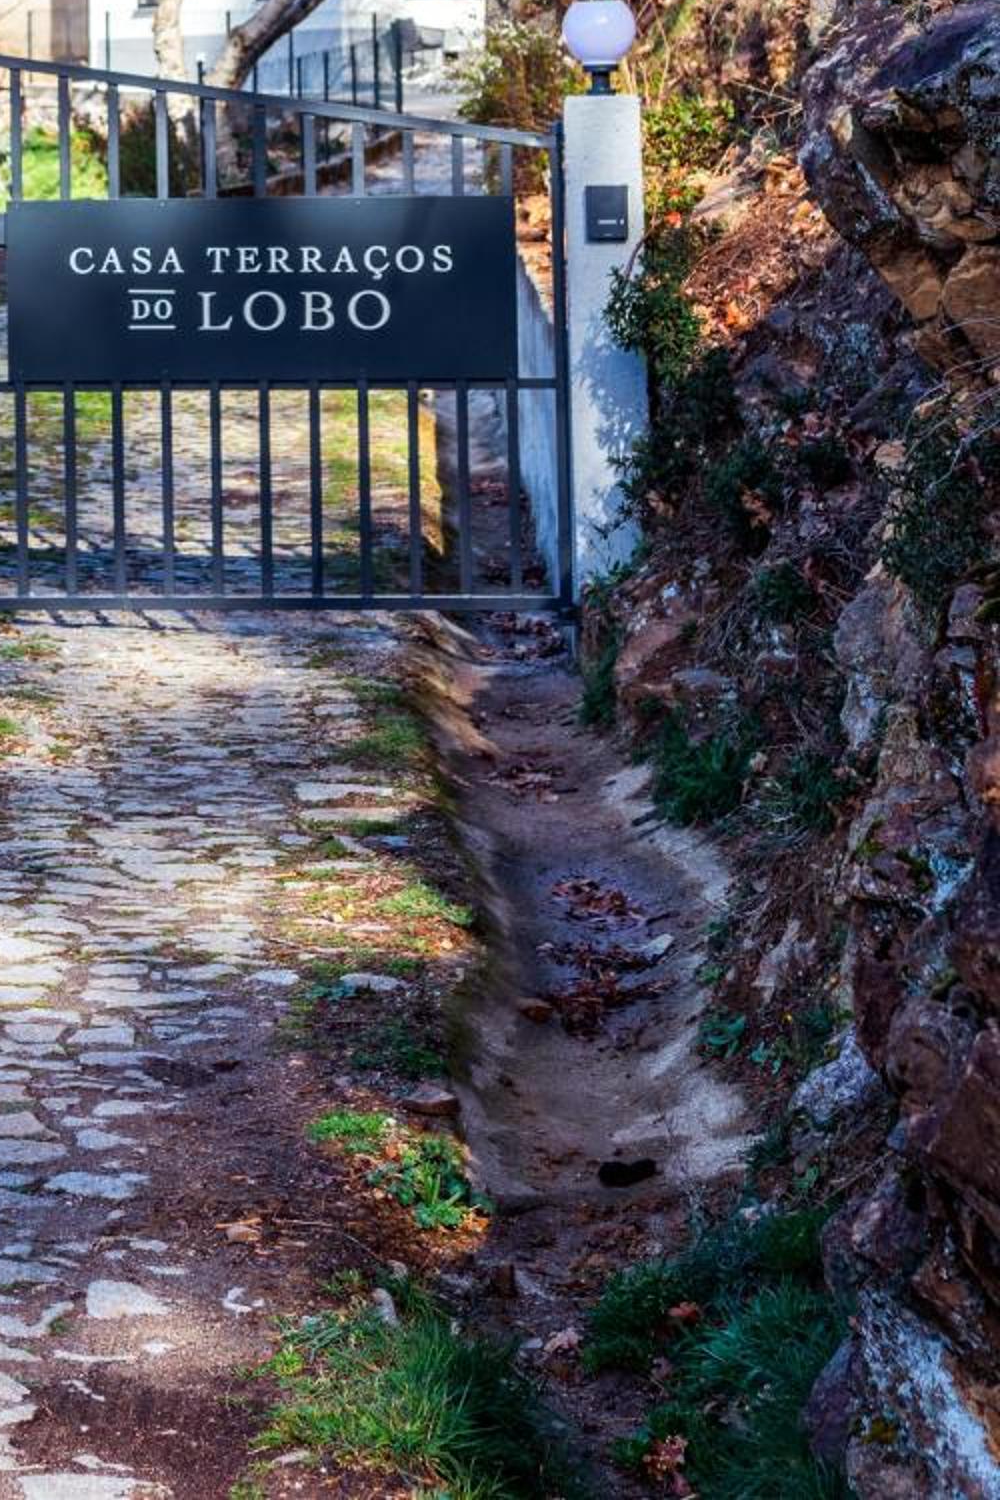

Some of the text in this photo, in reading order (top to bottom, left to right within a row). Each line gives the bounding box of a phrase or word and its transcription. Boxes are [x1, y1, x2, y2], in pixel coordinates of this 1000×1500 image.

[68, 245, 455, 279] CASA TERRAÇOS
[131, 289, 392, 332] DO LOBO
